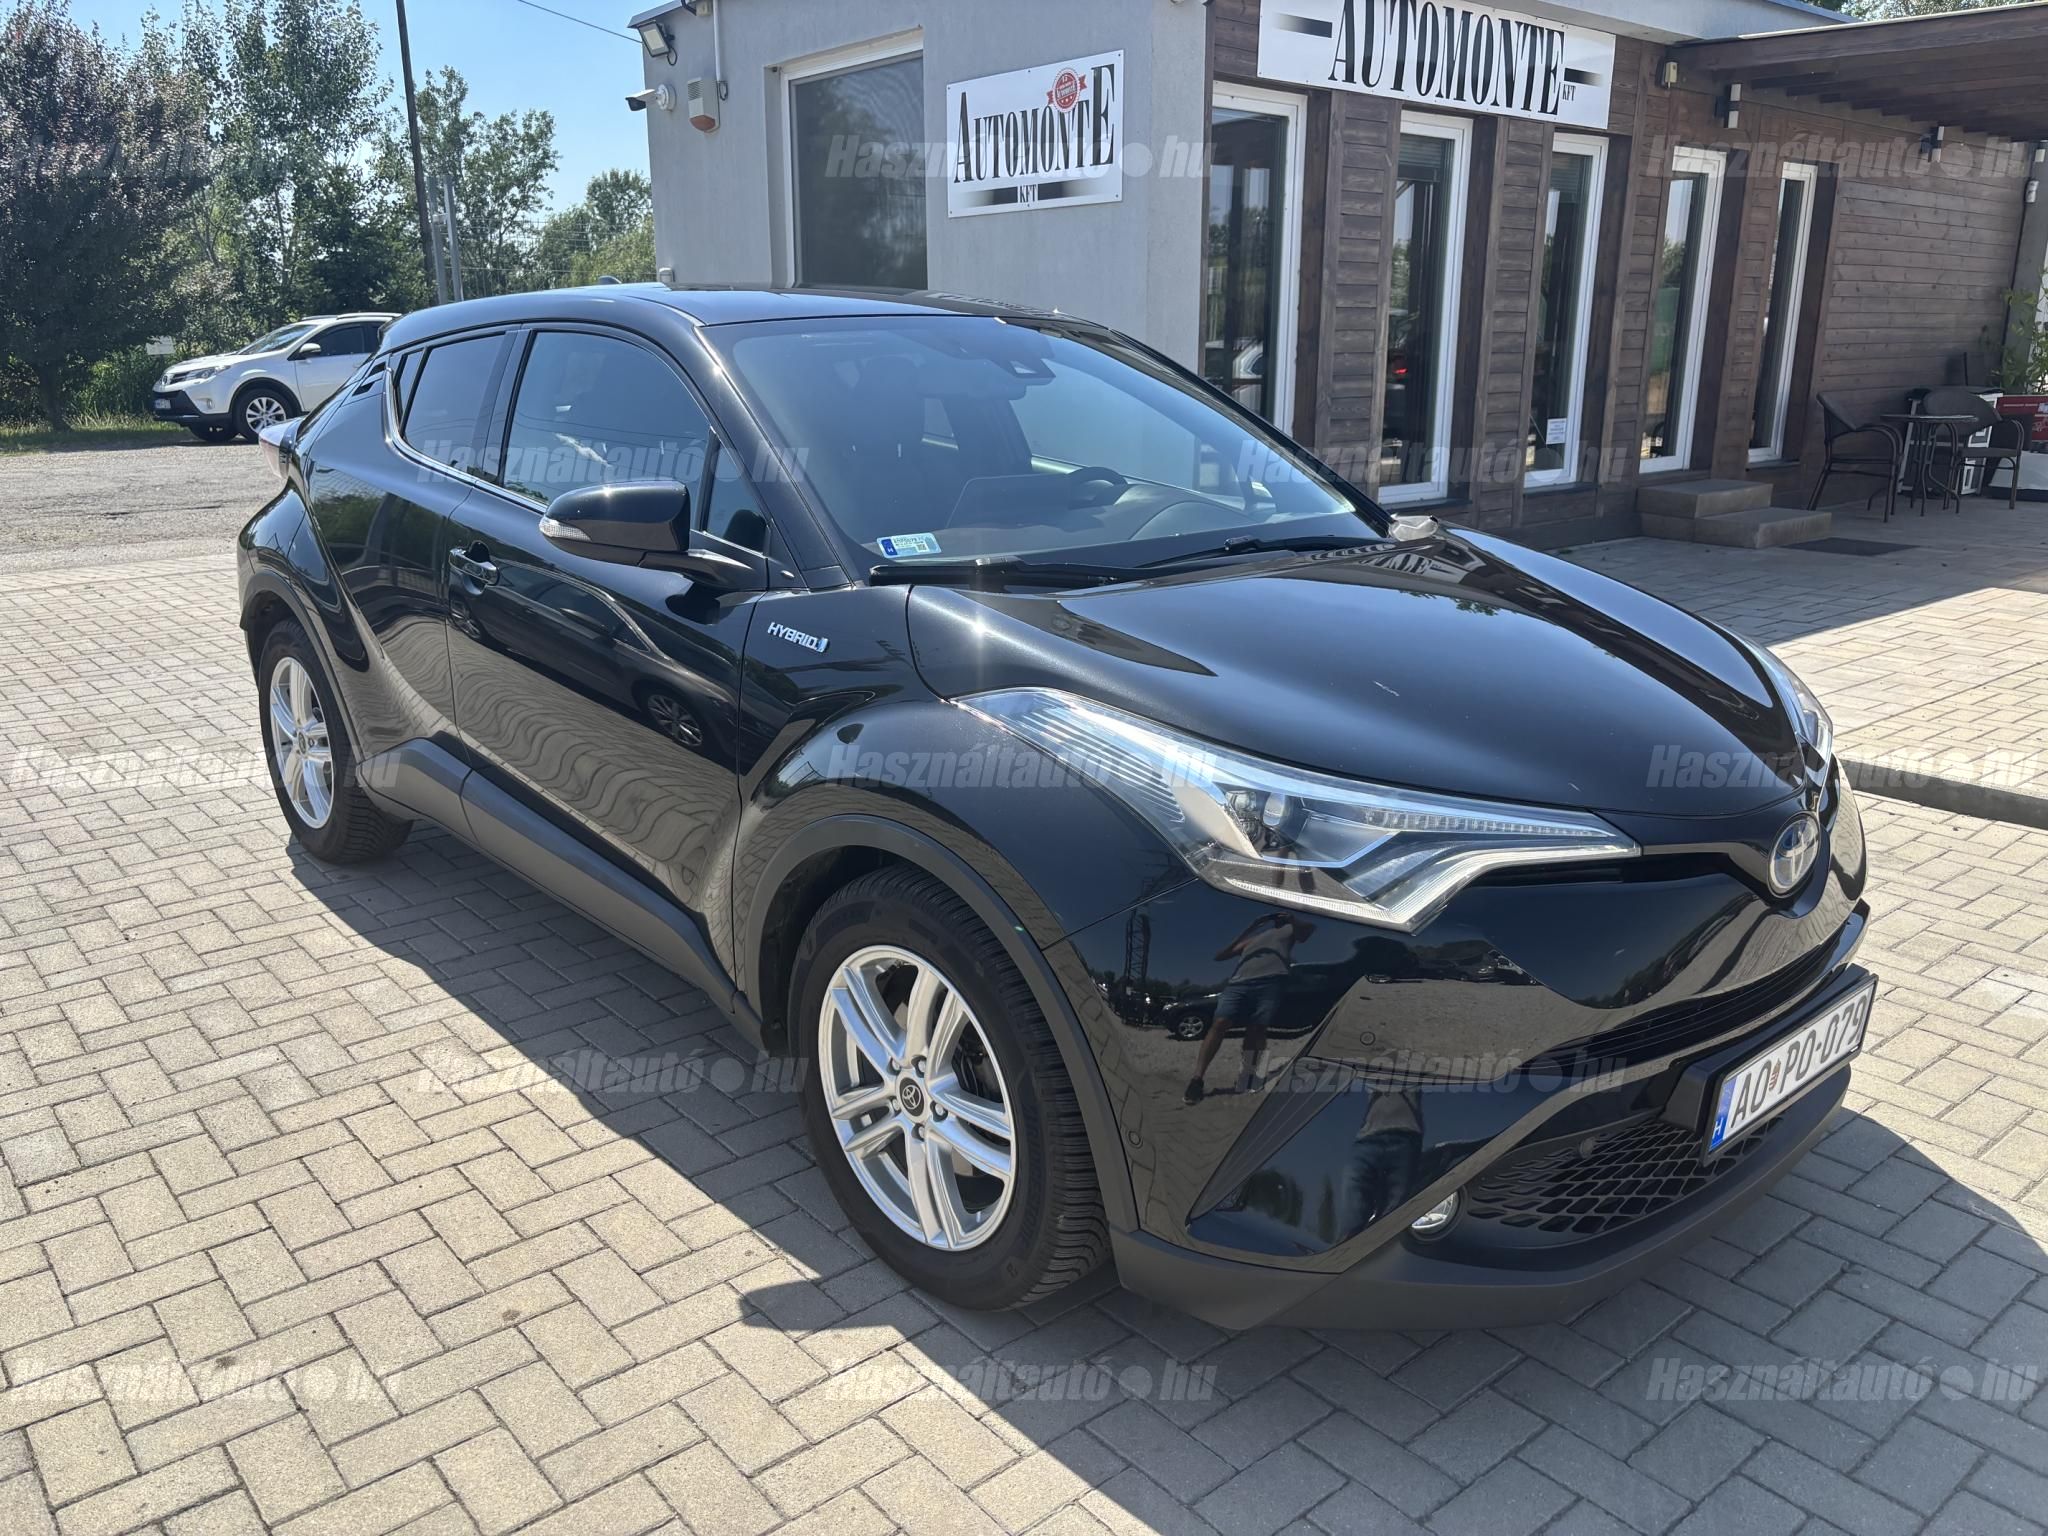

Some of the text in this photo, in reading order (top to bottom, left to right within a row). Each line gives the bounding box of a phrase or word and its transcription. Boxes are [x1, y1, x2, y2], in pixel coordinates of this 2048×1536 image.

[1328, 0, 1564, 115] AUTOMONTE
[1562, 85, 1576, 102] KFT
[954, 64, 1115, 183] AUTOMONTE
[1020, 184, 1037, 203] KFT
[767, 622, 819, 650] HYBRID
[1731, 1060, 1772, 1128] AO
